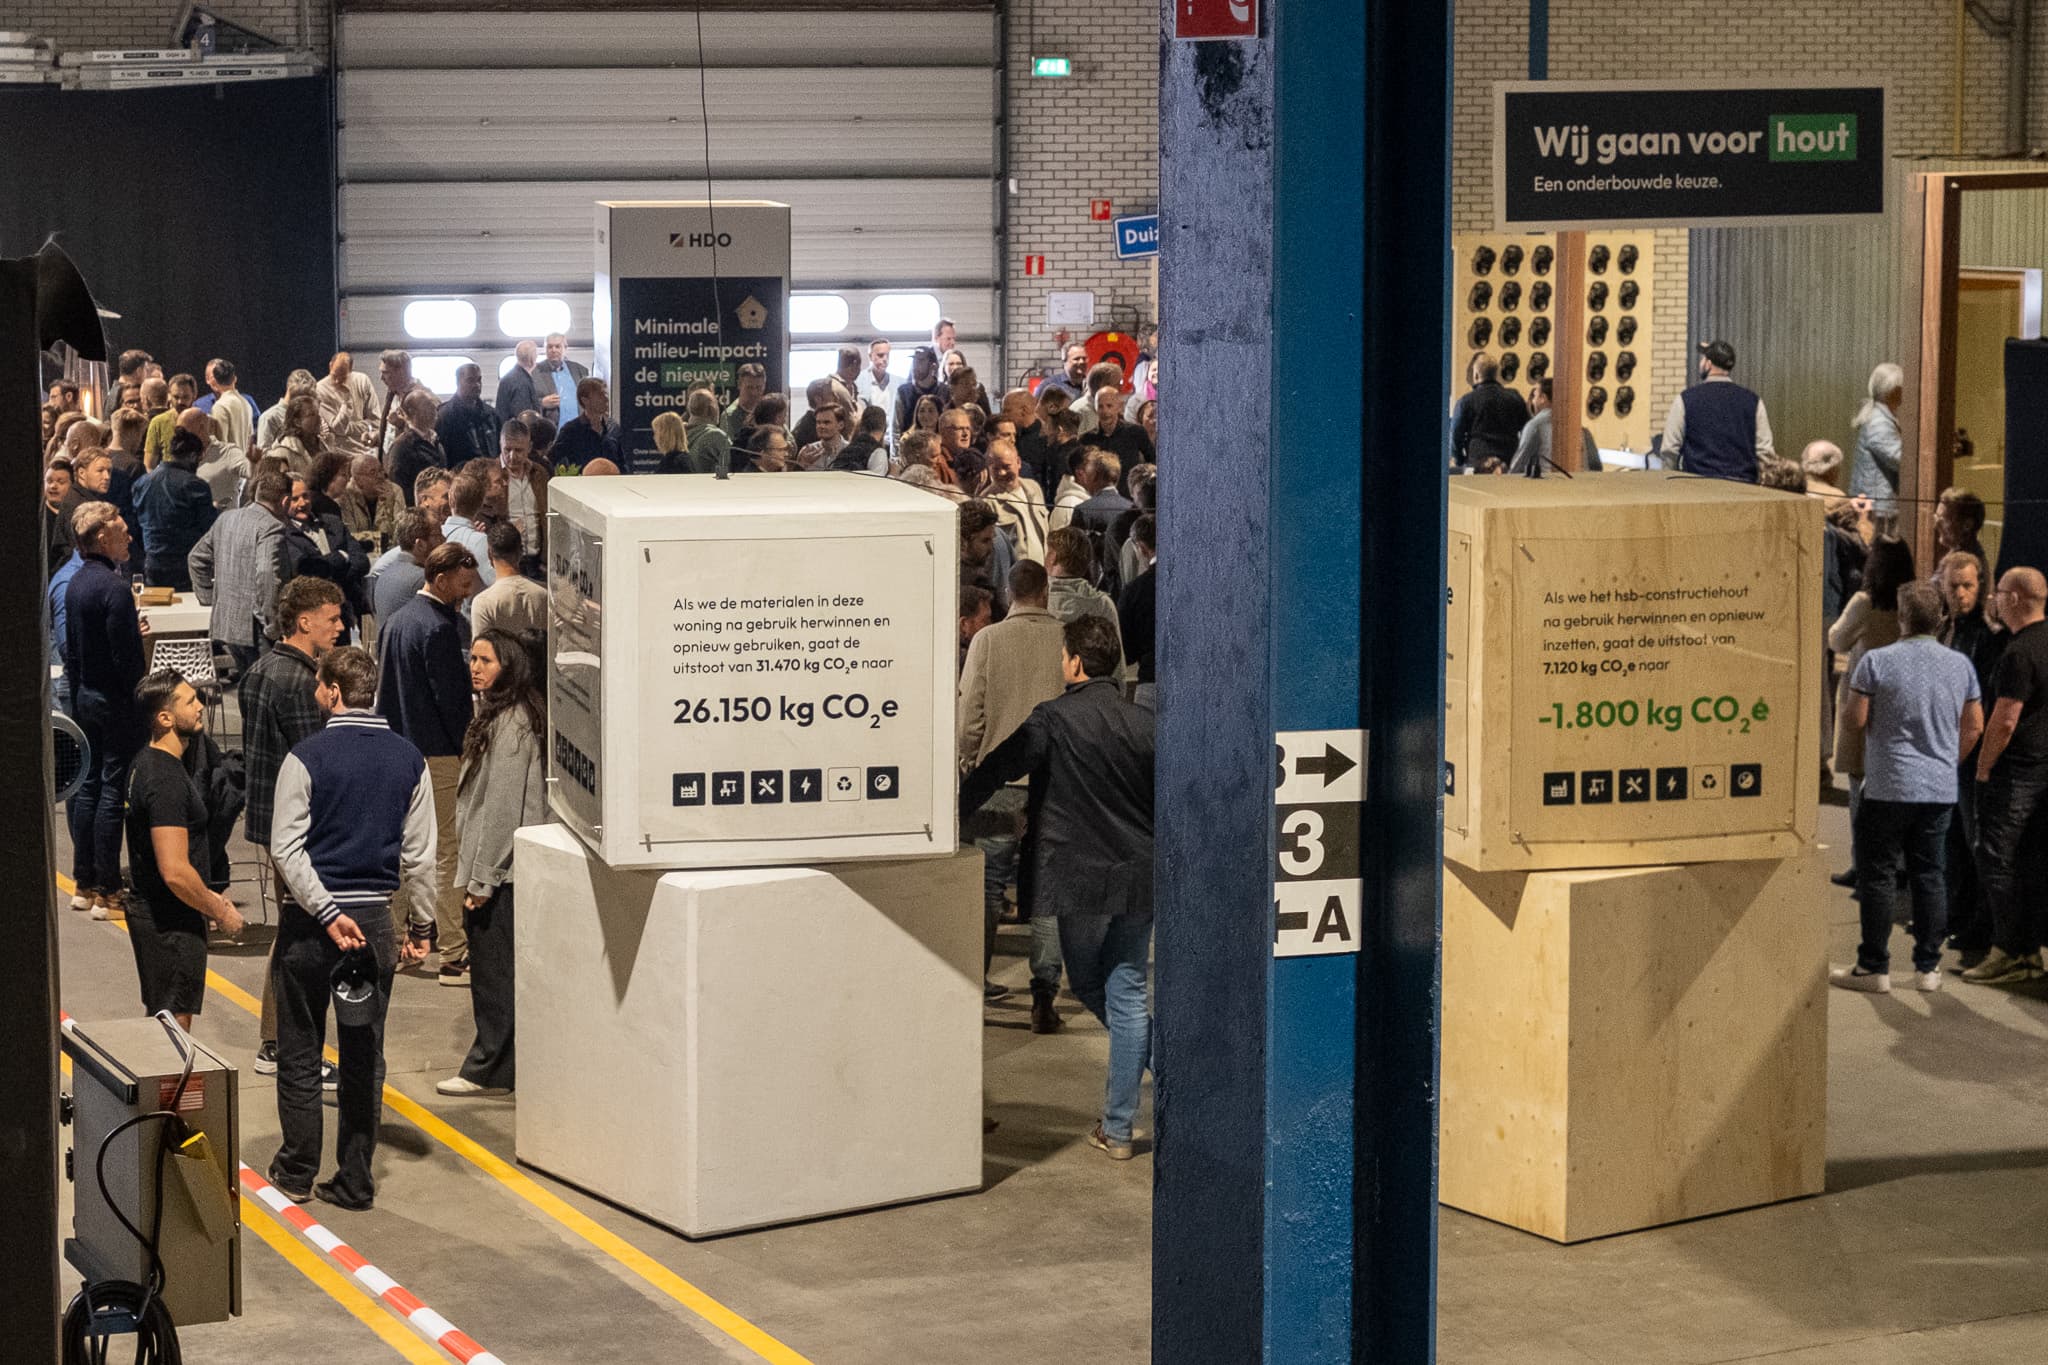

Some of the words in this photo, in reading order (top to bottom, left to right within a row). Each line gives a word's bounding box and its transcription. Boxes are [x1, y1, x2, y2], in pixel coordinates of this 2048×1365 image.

[1534, 126, 1588, 164] Wij
[1597, 133, 1680, 164] gaan
[1688, 132, 1762, 154] voor
[1778, 122, 1849, 152] hout
[1535, 176, 1562, 191] Een
[1567, 174, 1672, 191] onderbouwde
[1676, 174, 1722, 188] keuze.
[690, 233, 732, 248] HDO
[636, 318, 720, 334] Minimale
[636, 342, 767, 361] milieu-impact:
[635, 367, 657, 382] de
[666, 367, 730, 384] nieuwe
[635, 390, 730, 407] standd
[674, 598, 693, 611] Als
[698, 600, 716, 610] we
[720, 597, 736, 610] de
[741, 595, 814, 609] materialen
[818, 594, 828, 607] in
[833, 594, 864, 607] deze
[1544, 591, 1564, 605] Als
[1568, 593, 1586, 604] we
[1590, 590, 1611, 603] het
[1615, 586, 1748, 602] hsb-constructiehout
[674, 618, 721, 634] woning
[727, 621, 742, 631] na
[746, 616, 796, 634] gebruik
[801, 616, 870, 629] herwinnen
[874, 617, 889, 627] en
[1544, 618, 1560, 628] na
[1564, 612, 1614, 631] gebruik
[1618, 611, 1686, 626] herwinnen
[1690, 612, 1706, 623] en
[1709, 609, 1765, 625] opnieuw
[674, 640, 730, 656] opnieuw
[734, 637, 804, 655] gebruiken,
[809, 637, 839, 653] gaat
[844, 635, 860, 649] de
[1544, 637, 1599, 652] inzetten,
[1603, 635, 1634, 653] gaat
[1638, 634, 1654, 649] de
[1658, 633, 1707, 648] uitstoot
[1712, 635, 1735, 645] van
[674, 661, 724, 675] uitstoot
[728, 663, 752, 673] van
[757, 658, 800, 672] 31.470
[804, 658, 819, 674] kg
[862, 659, 893, 669] naar
[1544, 660, 1577, 675] 7.120
[1581, 660, 1597, 677] kg
[1639, 660, 1670, 673] naar
[674, 697, 771, 723] 26.150
[780, 696, 813, 727] kg
[1539, 700, 1639, 729] -1.800
[1648, 699, 1682, 731] kg
[1279, 809, 1325, 876] 3
[1312, 895, 1352, 943] A
